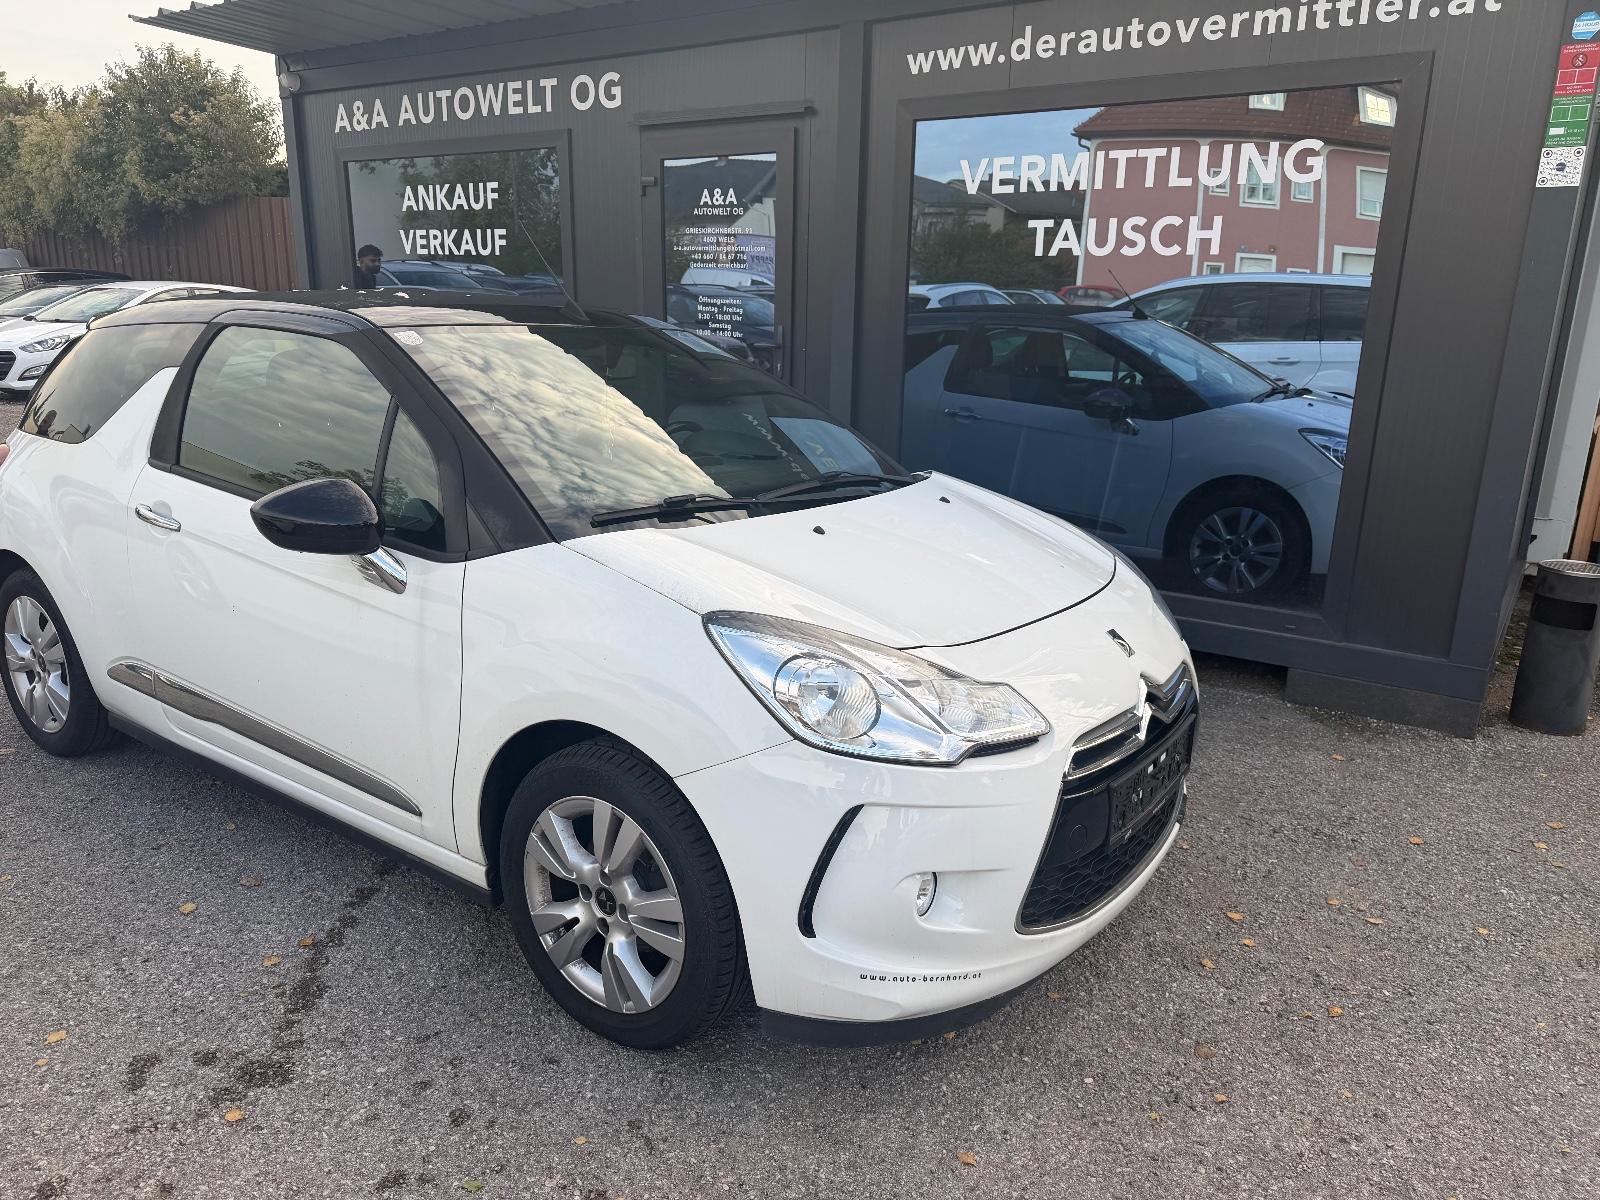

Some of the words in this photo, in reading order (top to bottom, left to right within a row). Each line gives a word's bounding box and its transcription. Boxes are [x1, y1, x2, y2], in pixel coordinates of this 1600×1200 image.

[335, 98, 389, 133] A&A
[398, 77, 558, 126] AUTOWELT
[570, 71, 622, 111] OG
[960, 138, 1325, 195] VERMITTLUNG
[401, 181, 499, 212] ANKAUF
[699, 187, 738, 205] A&A
[693, 207, 731, 215] AUTOWELT
[732, 207, 744, 215] OG
[399, 228, 507, 256] VERKAUF
[1028, 215, 1223, 257] TAUSCH
[708, 322, 731, 330] Samstag
[859, 972, 982, 983] www.auto-bernhard.at
